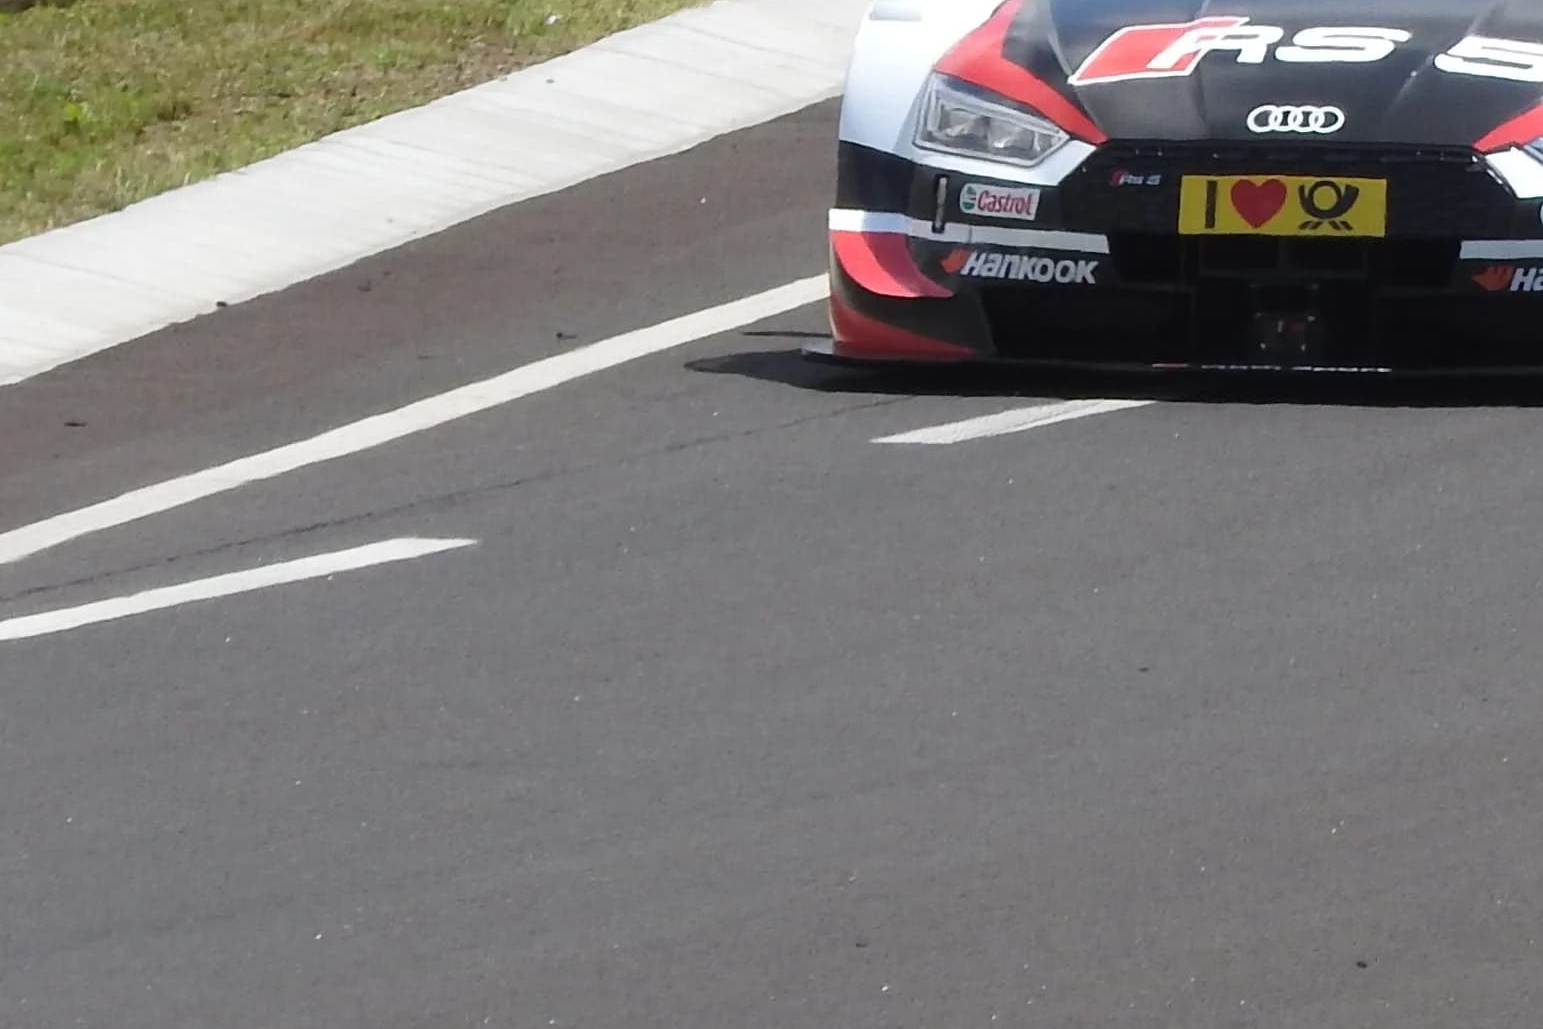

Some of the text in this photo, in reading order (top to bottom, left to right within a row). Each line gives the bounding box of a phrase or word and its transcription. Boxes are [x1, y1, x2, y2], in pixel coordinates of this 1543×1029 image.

[1147, 23, 1412, 70] RS
[977, 189, 1032, 216] Castrol
[1205, 179, 1218, 229] I
